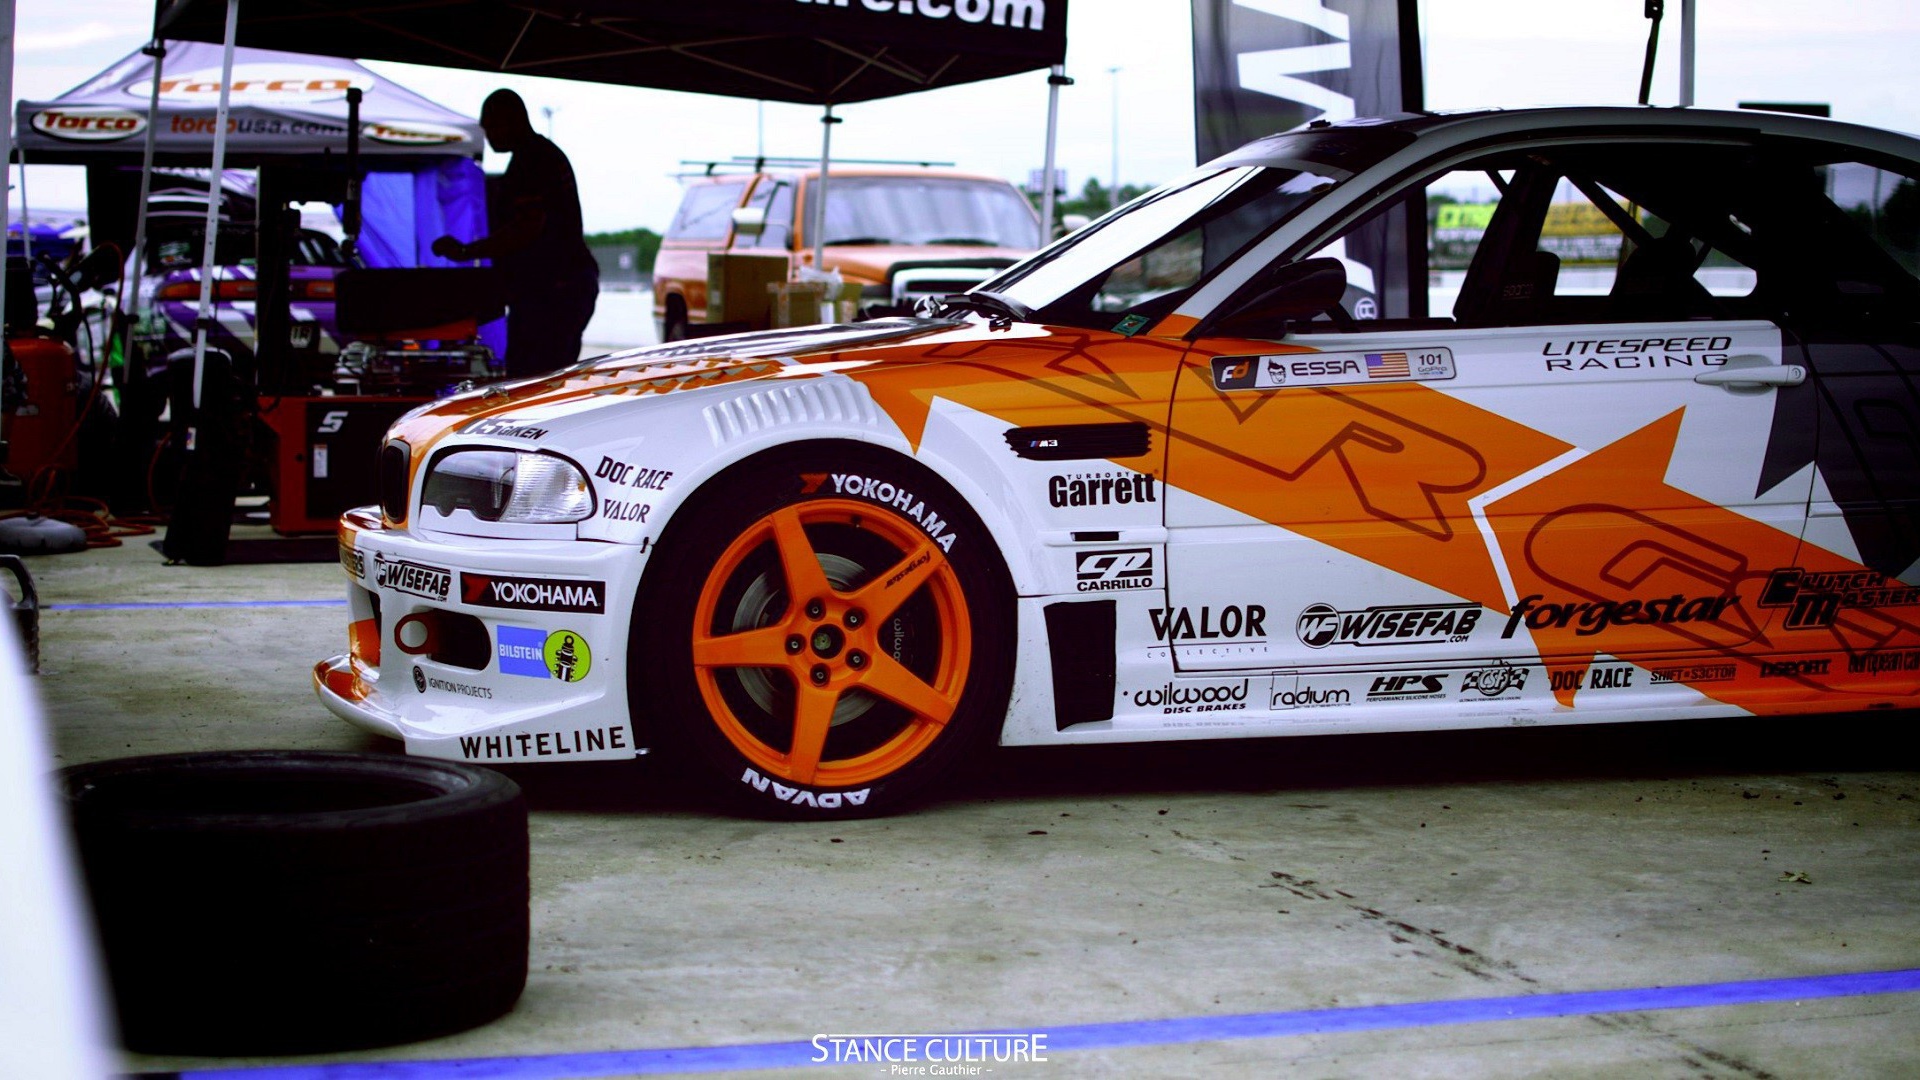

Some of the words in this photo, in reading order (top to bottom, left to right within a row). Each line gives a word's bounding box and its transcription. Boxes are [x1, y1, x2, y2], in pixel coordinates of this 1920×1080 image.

[43, 111, 138, 131] Torco
[1542, 336, 1732, 356] LITESPEED
[1291, 360, 1361, 376] ESSA
[1418, 353, 1442, 365] 101
[1545, 354, 1729, 371] RACING
[498, 425, 548, 440] GIKEN
[595, 455, 632, 485] DOC
[631, 468, 673, 491] RACE
[1067, 472, 1111, 480] TURBO
[1049, 473, 1157, 508] Garrett
[604, 498, 651, 523] VALOR
[831, 473, 957, 553] YOKOHAMA
[388, 564, 452, 597] WISEFAB
[1076, 577, 1153, 592] CARRILLO
[491, 580, 599, 608] YOKOHAMA
[1147, 604, 1267, 641] VALOR
[1340, 609, 1482, 640] WISEFAB
[1500, 593, 1742, 639] forgestar
[893, 617, 905, 661] wilwo
[1445, 635, 1469, 643] .COM
[499, 643, 543, 661] BILSTEIN
[1146, 647, 1268, 659] COLECTIVE
[1369, 674, 1449, 693] HPS
[1479, 668, 1508, 690] CSF
[1551, 669, 1584, 691] DOC
[1590, 667, 1634, 689] RACE
[1650, 669, 1684, 682] SHIFT
[428, 678, 457, 694] IGNITION
[456, 683, 493, 699] PROJECTS
[1134, 678, 1249, 707] wilwood
[1273, 686, 1350, 706] radium
[1163, 705, 1193, 714] DISC
[1196, 702, 1247, 713] BRAKES
[459, 726, 626, 759] WHITELINE
[741, 767, 871, 809] ADVAN
